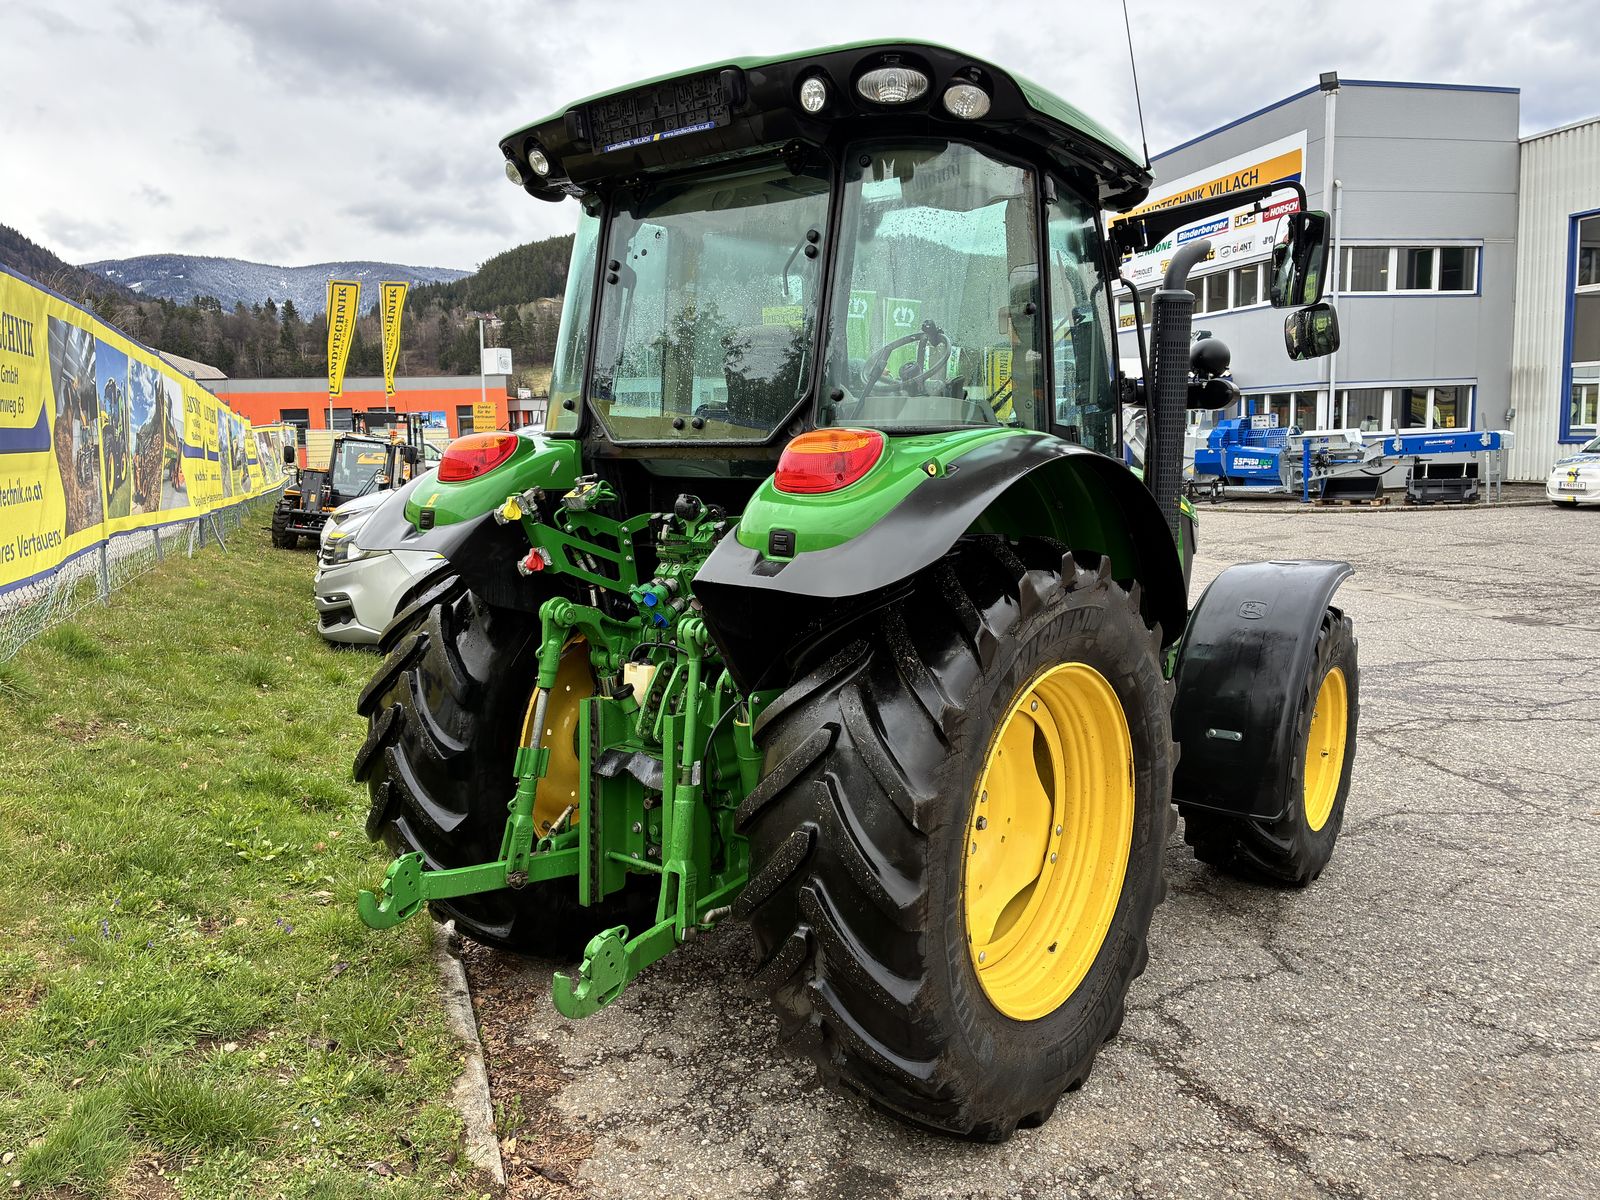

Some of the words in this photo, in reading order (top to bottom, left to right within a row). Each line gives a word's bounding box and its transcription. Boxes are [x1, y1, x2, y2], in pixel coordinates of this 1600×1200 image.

[1209, 168, 1259, 197] VILLACH
[1235, 213, 1255, 226] JCB
[1269, 201, 1299, 217] HORSCH
[1178, 219, 1228, 241] Binderberger
[0, 311, 35, 358] CHNIK
[329, 287, 347, 389] LANDTECHNIK
[1, 364, 19, 384] GmbH
[18, 396, 25, 414] 63
[0, 477, 43, 507] technik.co.at
